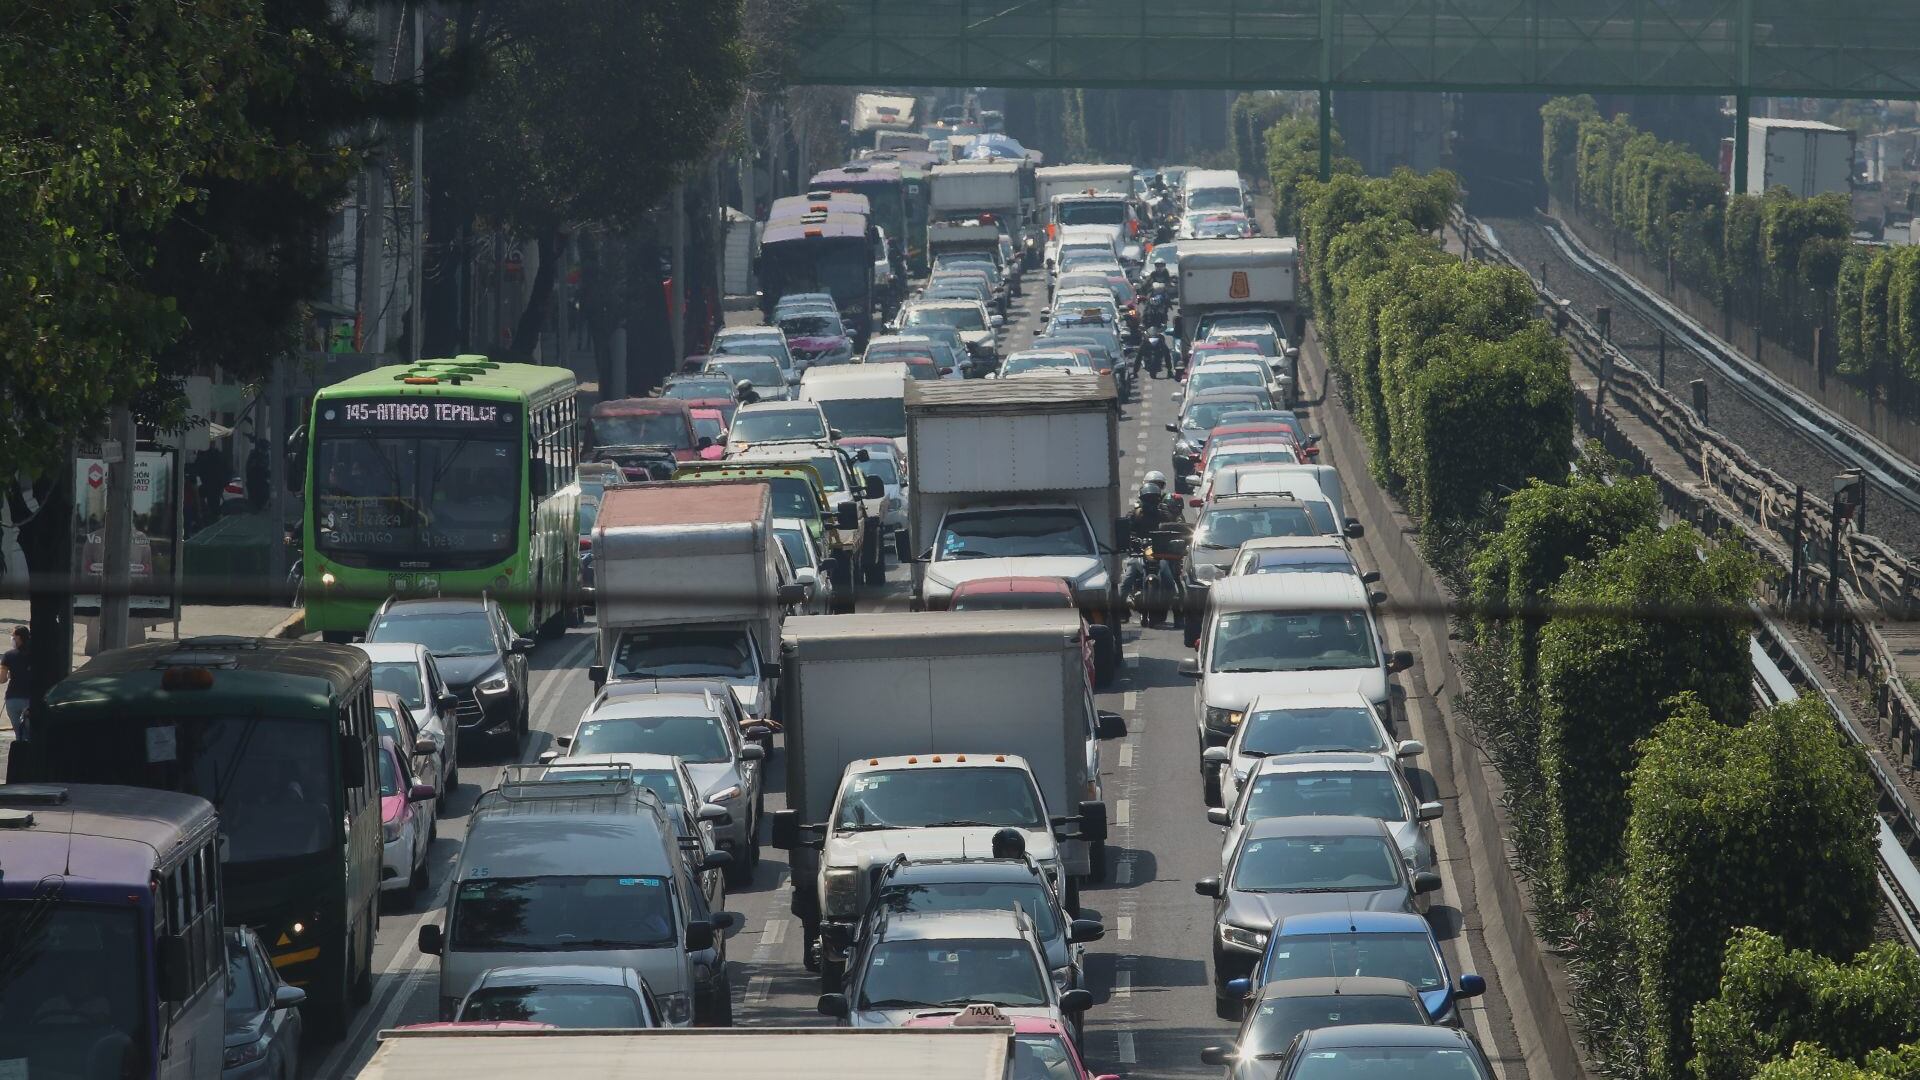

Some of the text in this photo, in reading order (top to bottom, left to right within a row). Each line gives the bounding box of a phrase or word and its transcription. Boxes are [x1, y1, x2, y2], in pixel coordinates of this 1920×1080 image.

[329, 530, 393, 544] SANTIAGO
[471, 867, 489, 877] 25
[969, 1006, 995, 1016] TAXI
